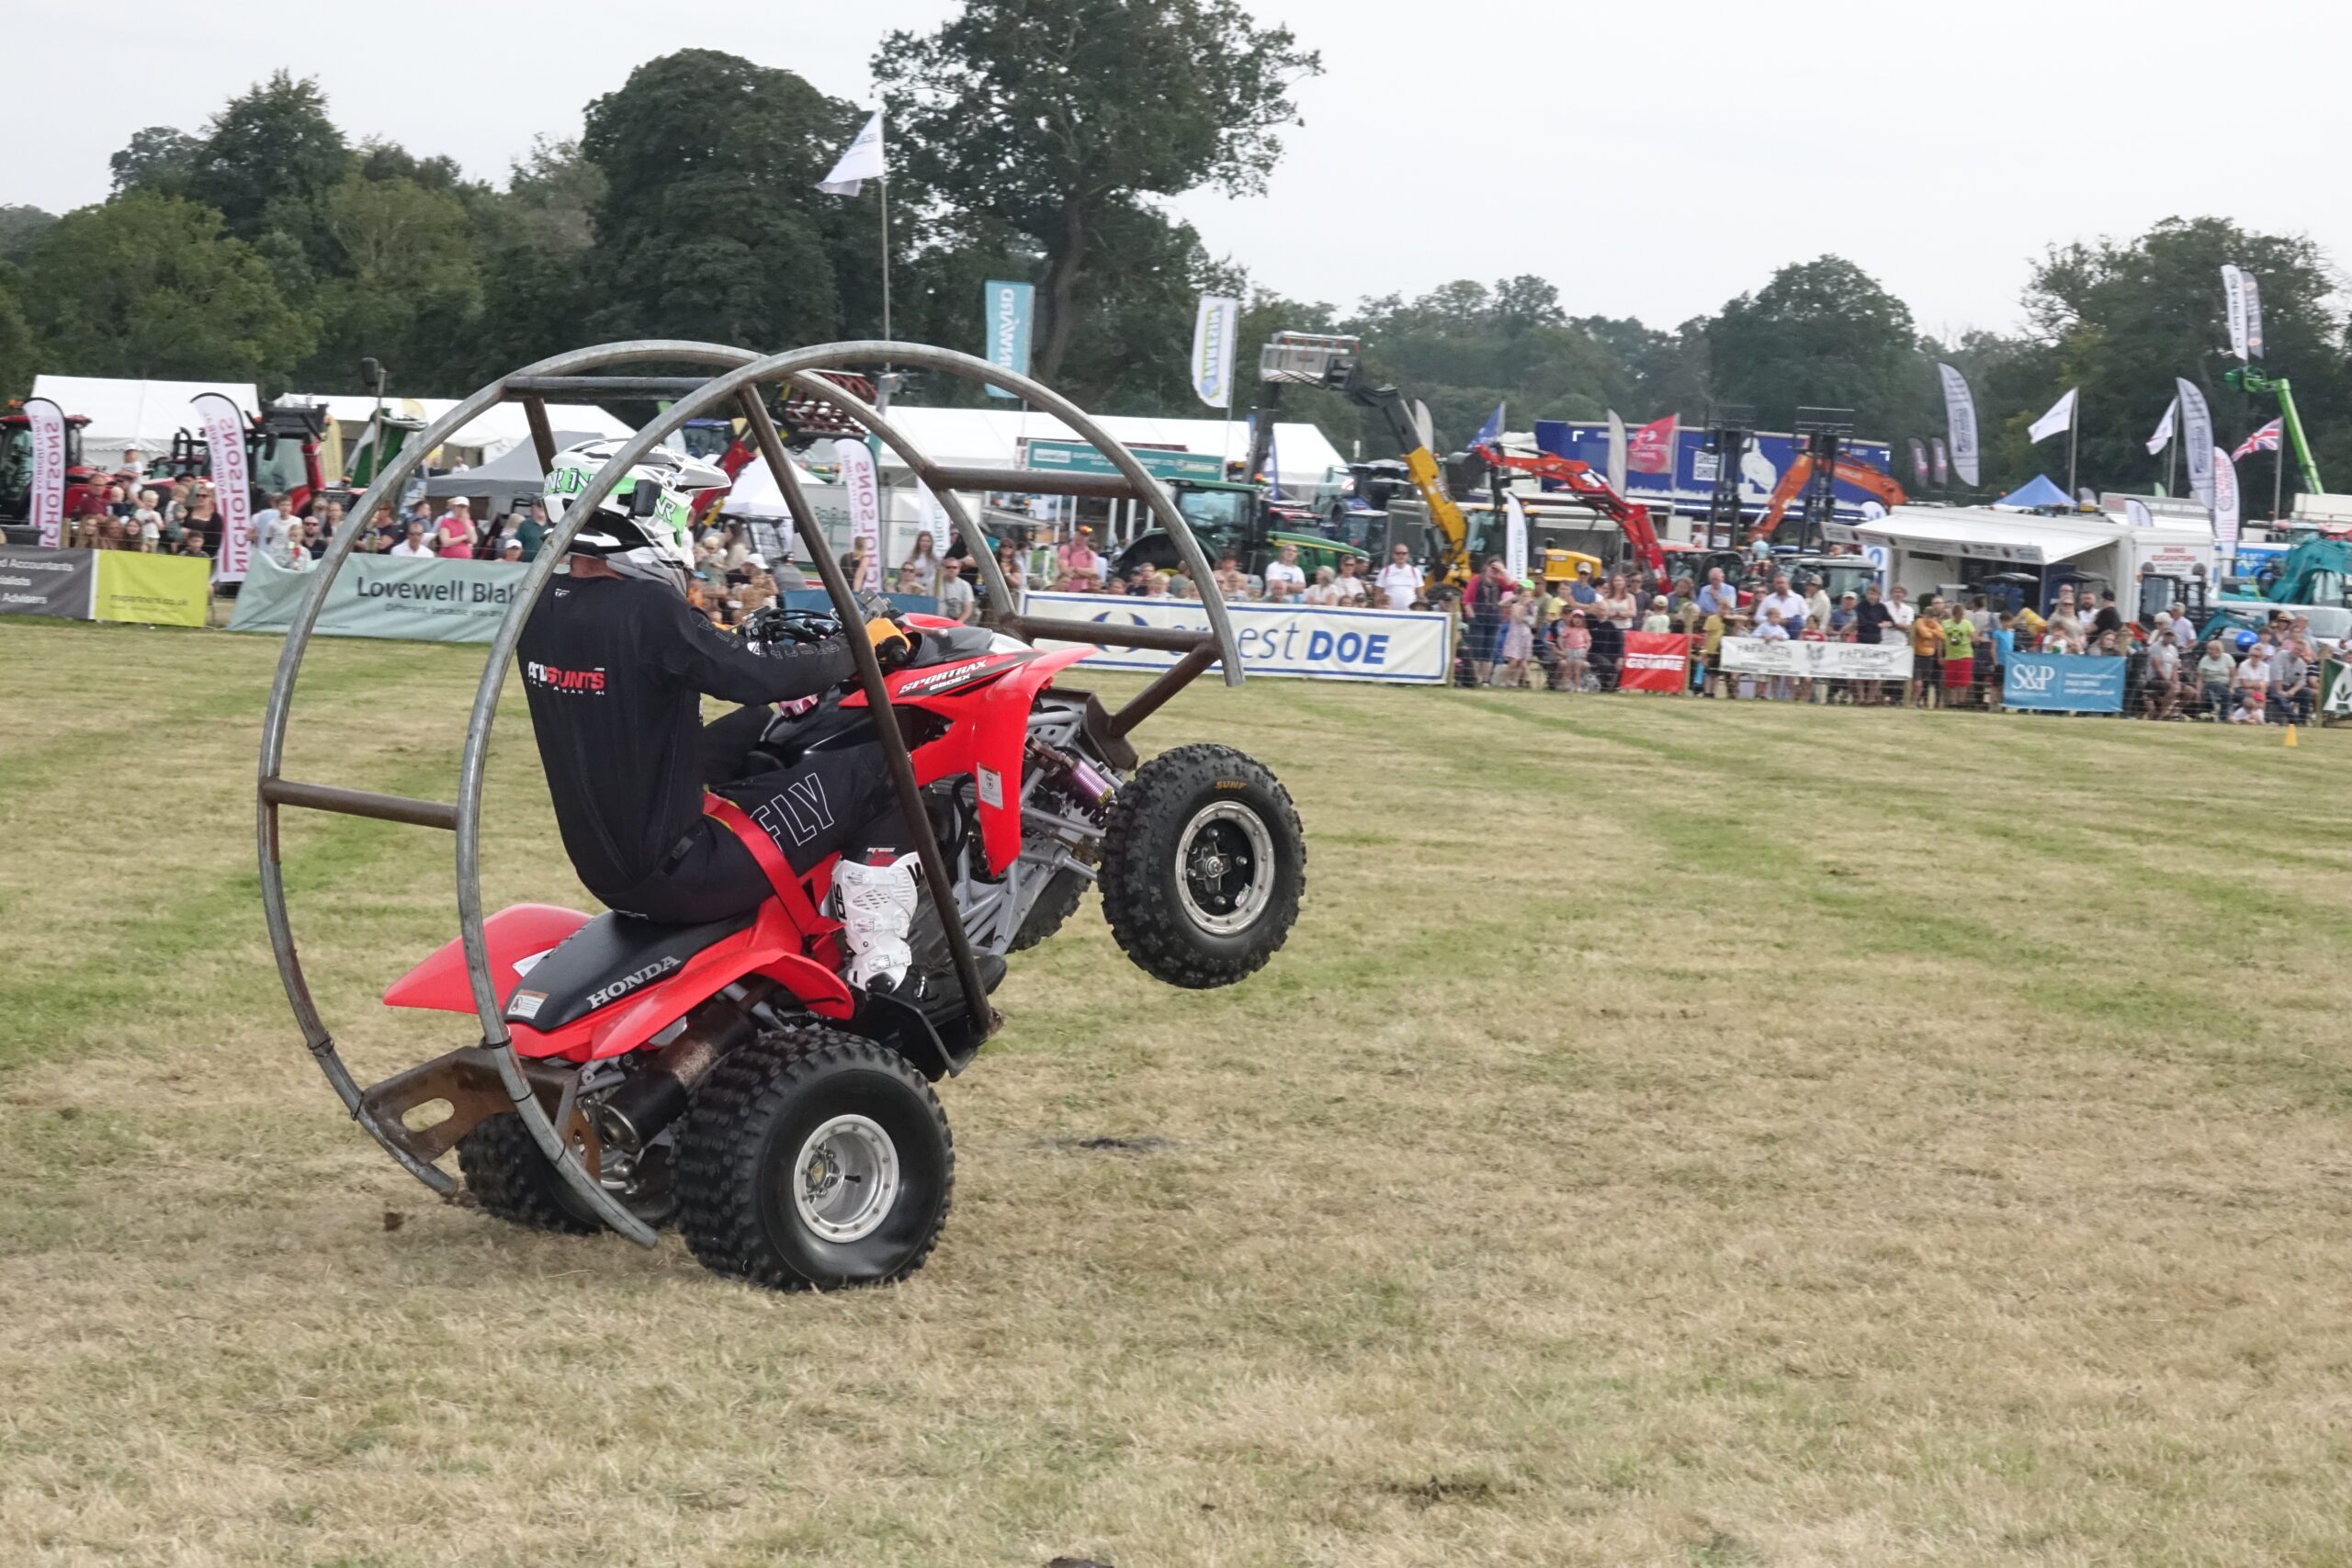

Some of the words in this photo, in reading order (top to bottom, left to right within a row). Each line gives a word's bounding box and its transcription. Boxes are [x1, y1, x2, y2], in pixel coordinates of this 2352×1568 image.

[9, 558, 74, 571] Accountants
[0, 575, 31, 586] ialists
[357, 576, 463, 602] Lovewell
[1306, 630, 1390, 665] DOE
[899, 660, 987, 694] SPORTRAX
[2010, 663, 2055, 691] S&P
[750, 773, 835, 852] FLY
[586, 955, 682, 1010] HONDA
